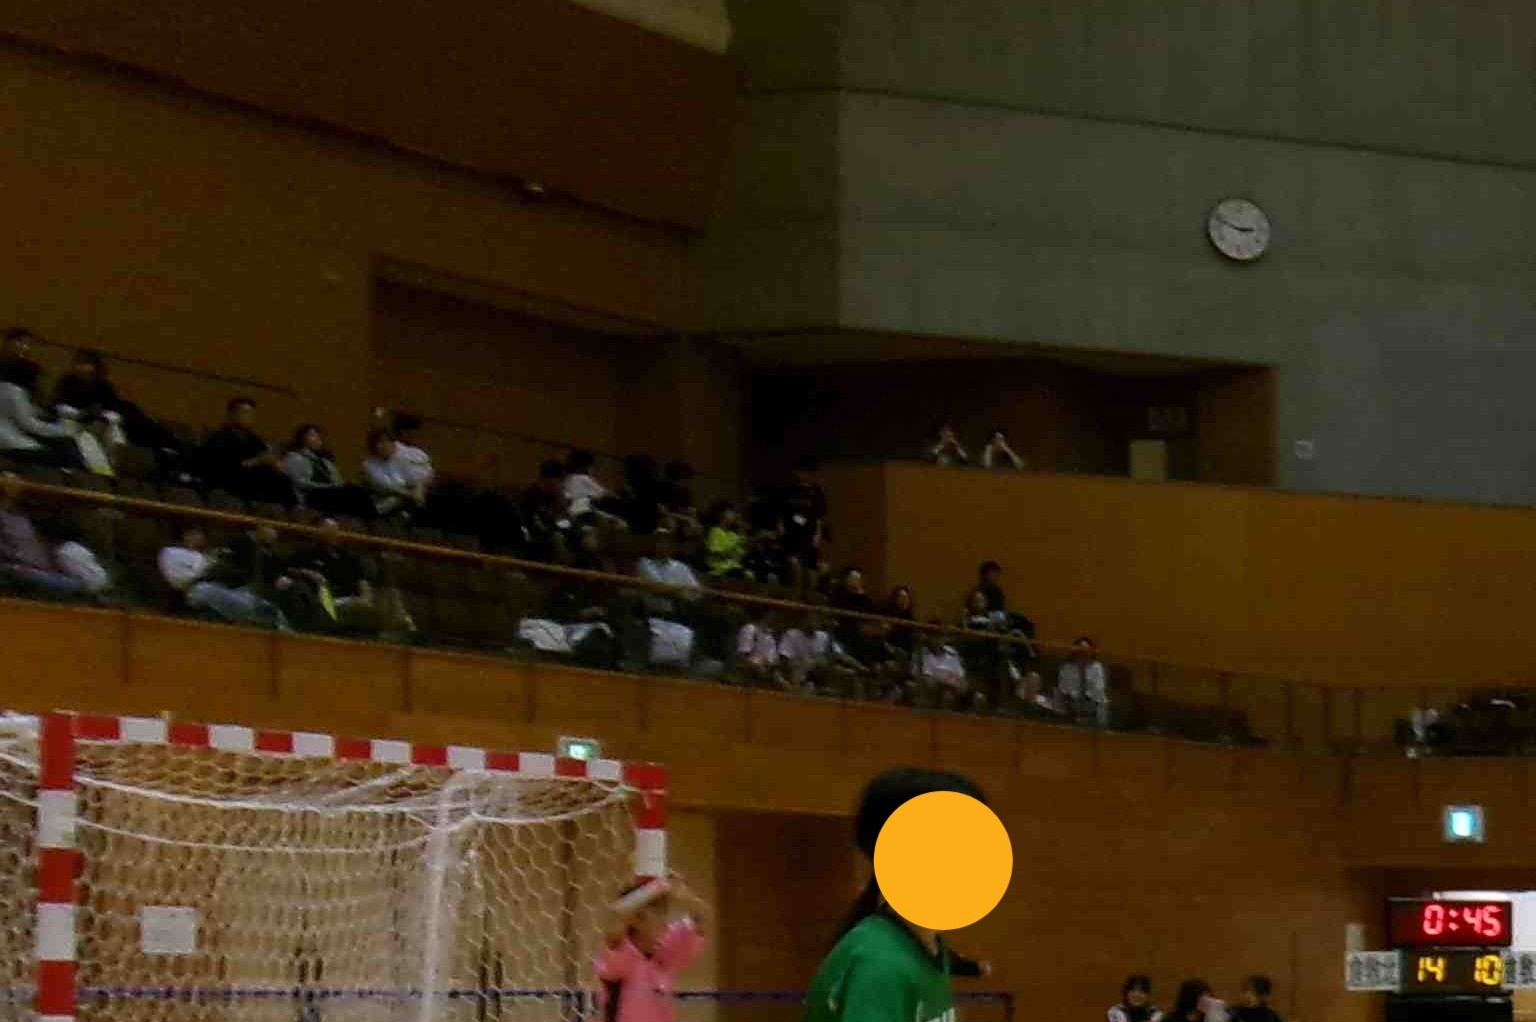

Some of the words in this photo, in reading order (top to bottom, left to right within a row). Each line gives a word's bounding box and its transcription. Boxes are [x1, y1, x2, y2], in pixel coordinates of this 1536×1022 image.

[1423, 904, 1502, 936] 0:45
[1417, 956, 1447, 983] 14
[1474, 955, 1503, 986] 10
